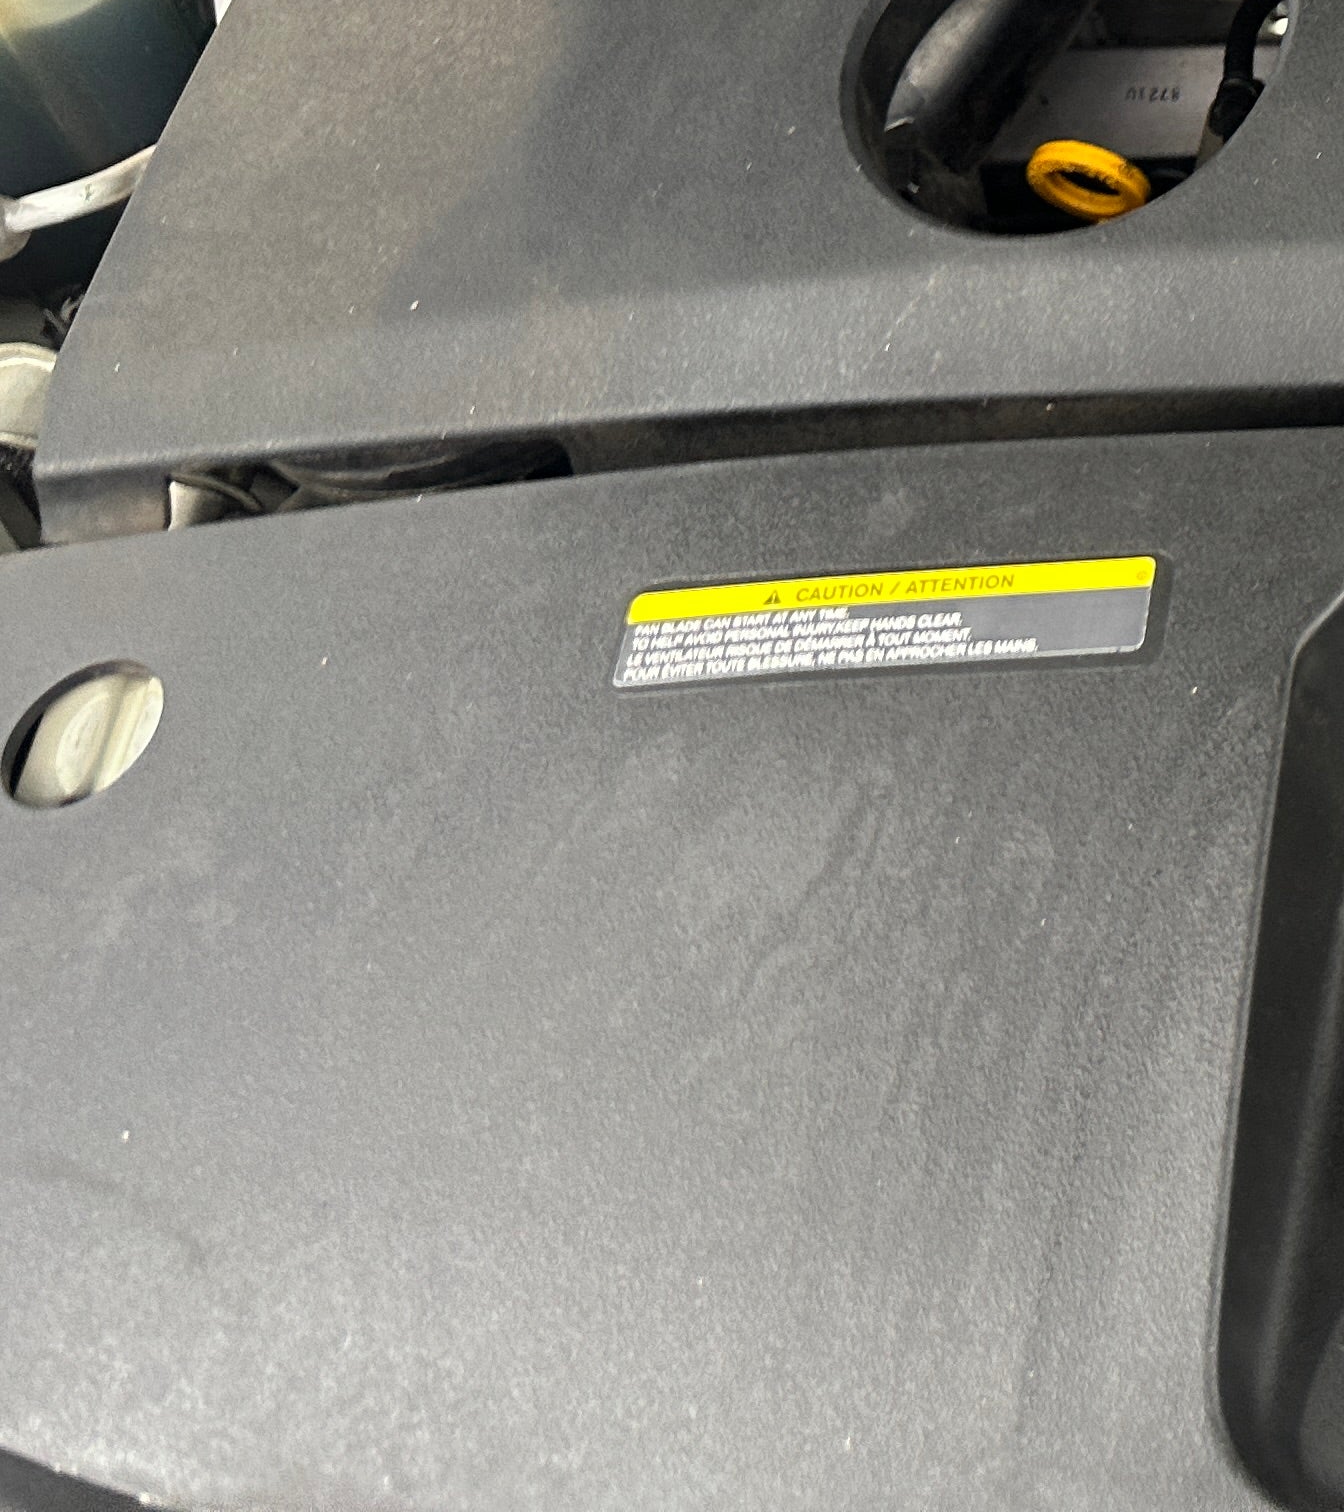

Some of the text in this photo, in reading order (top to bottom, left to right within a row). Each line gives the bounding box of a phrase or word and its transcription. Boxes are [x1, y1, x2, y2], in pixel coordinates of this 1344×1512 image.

[796, 582, 884, 603] CAUTION
[904, 574, 1015, 594] ATTENTION
[632, 637, 650, 651] TO
[650, 633, 684, 650] HELP
[684, 630, 724, 646] AVOID
[724, 625, 790, 642] PERSONAL
[869, 614, 917, 631] HANDS
[703, 615, 732, 632] CAN
[732, 611, 772, 629] START
[772, 610, 790, 625] AT
[789, 608, 817, 624] ANY
[623, 665, 661, 682] POUR
[705, 657, 747, 675] TOUTE
[817, 650, 838, 666] NE
[837, 647, 865, 665] PAS
[865, 646, 886, 663] EN
[885, 642, 967, 662] APPROCHER
[966, 639, 994, 656] LES
[626, 651, 644, 668] LE
[644, 645, 726, 666] VENTILATEUR
[725, 640, 774, 659] RISQUE
[773, 639, 794, 654] DE
[877, 631, 913, 647] TOUT
